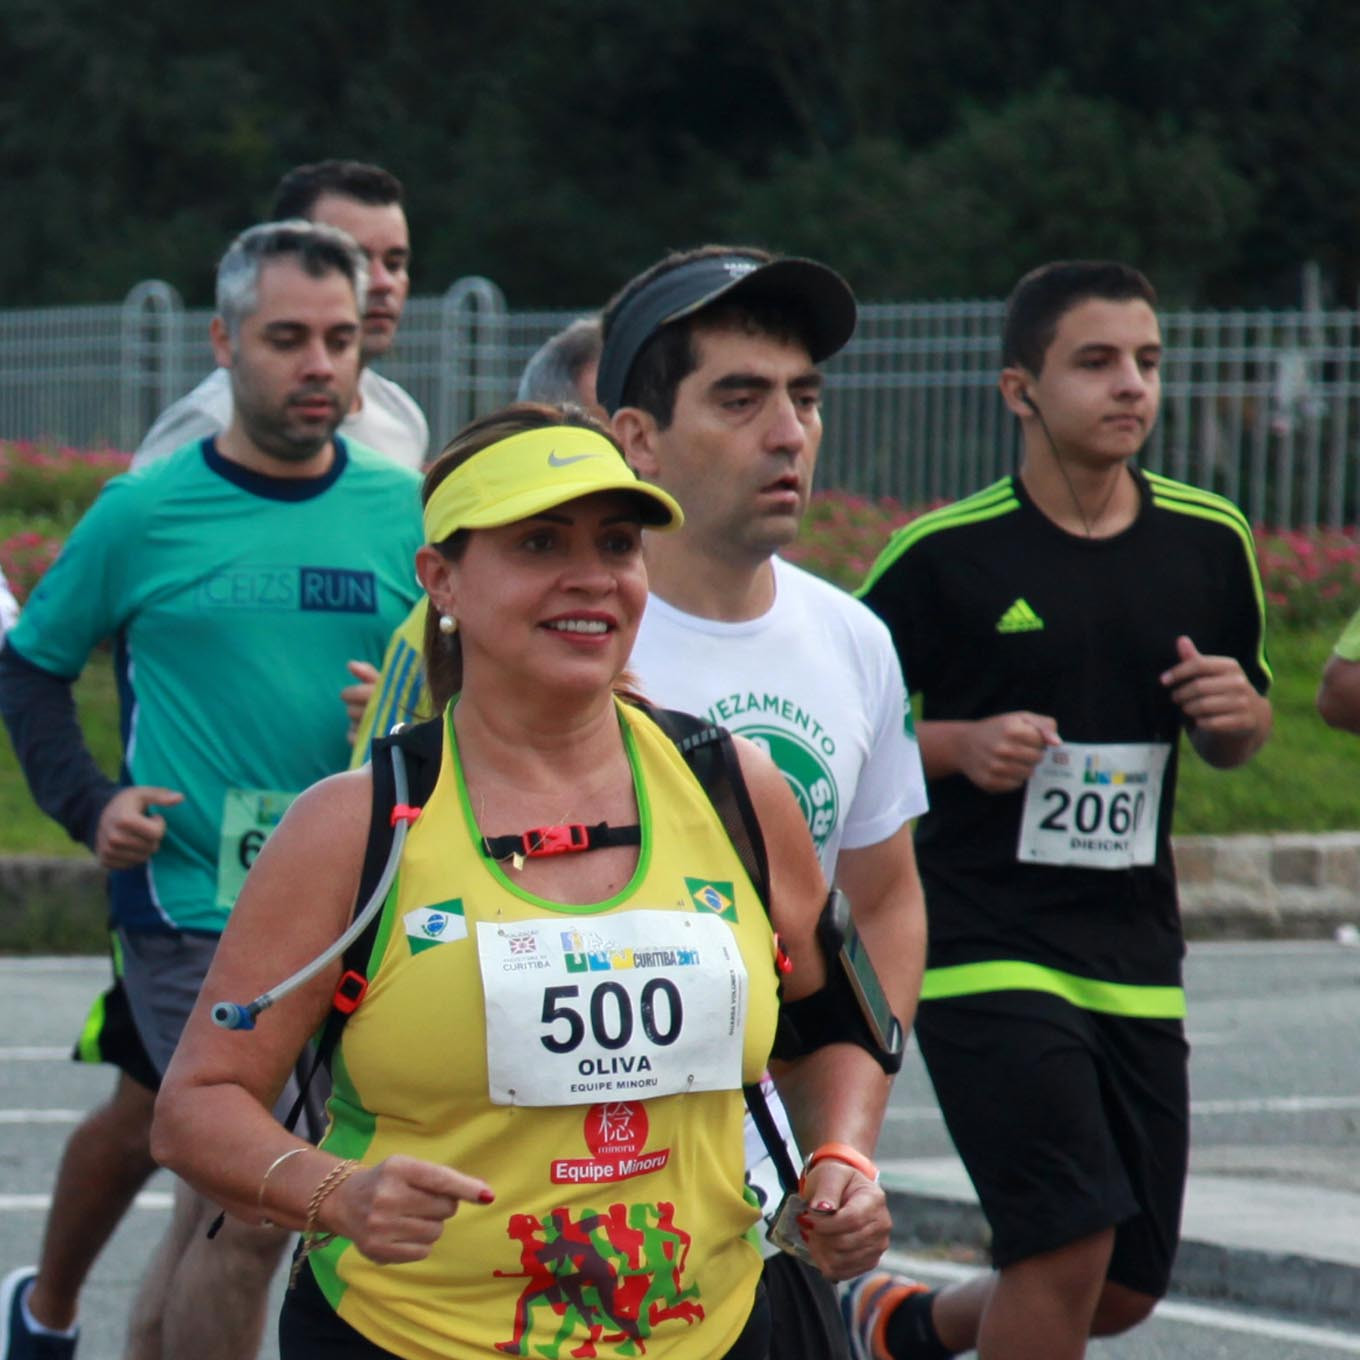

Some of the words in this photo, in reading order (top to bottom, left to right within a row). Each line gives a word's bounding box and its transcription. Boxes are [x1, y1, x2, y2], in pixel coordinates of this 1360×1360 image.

[303, 572, 374, 608] RUN
[633, 951, 677, 968] CURITIBA
[677, 949, 700, 966] 2017
[540, 977, 683, 1054] 500
[578, 1055, 652, 1076] OLIVA
[570, 1082, 612, 1093] EQUIPE
[616, 1078, 658, 1090] MINORU
[598, 1144, 636, 1154] minoru
[555, 1161, 615, 1182] Equipe
[618, 1154, 667, 1176] Minoru
